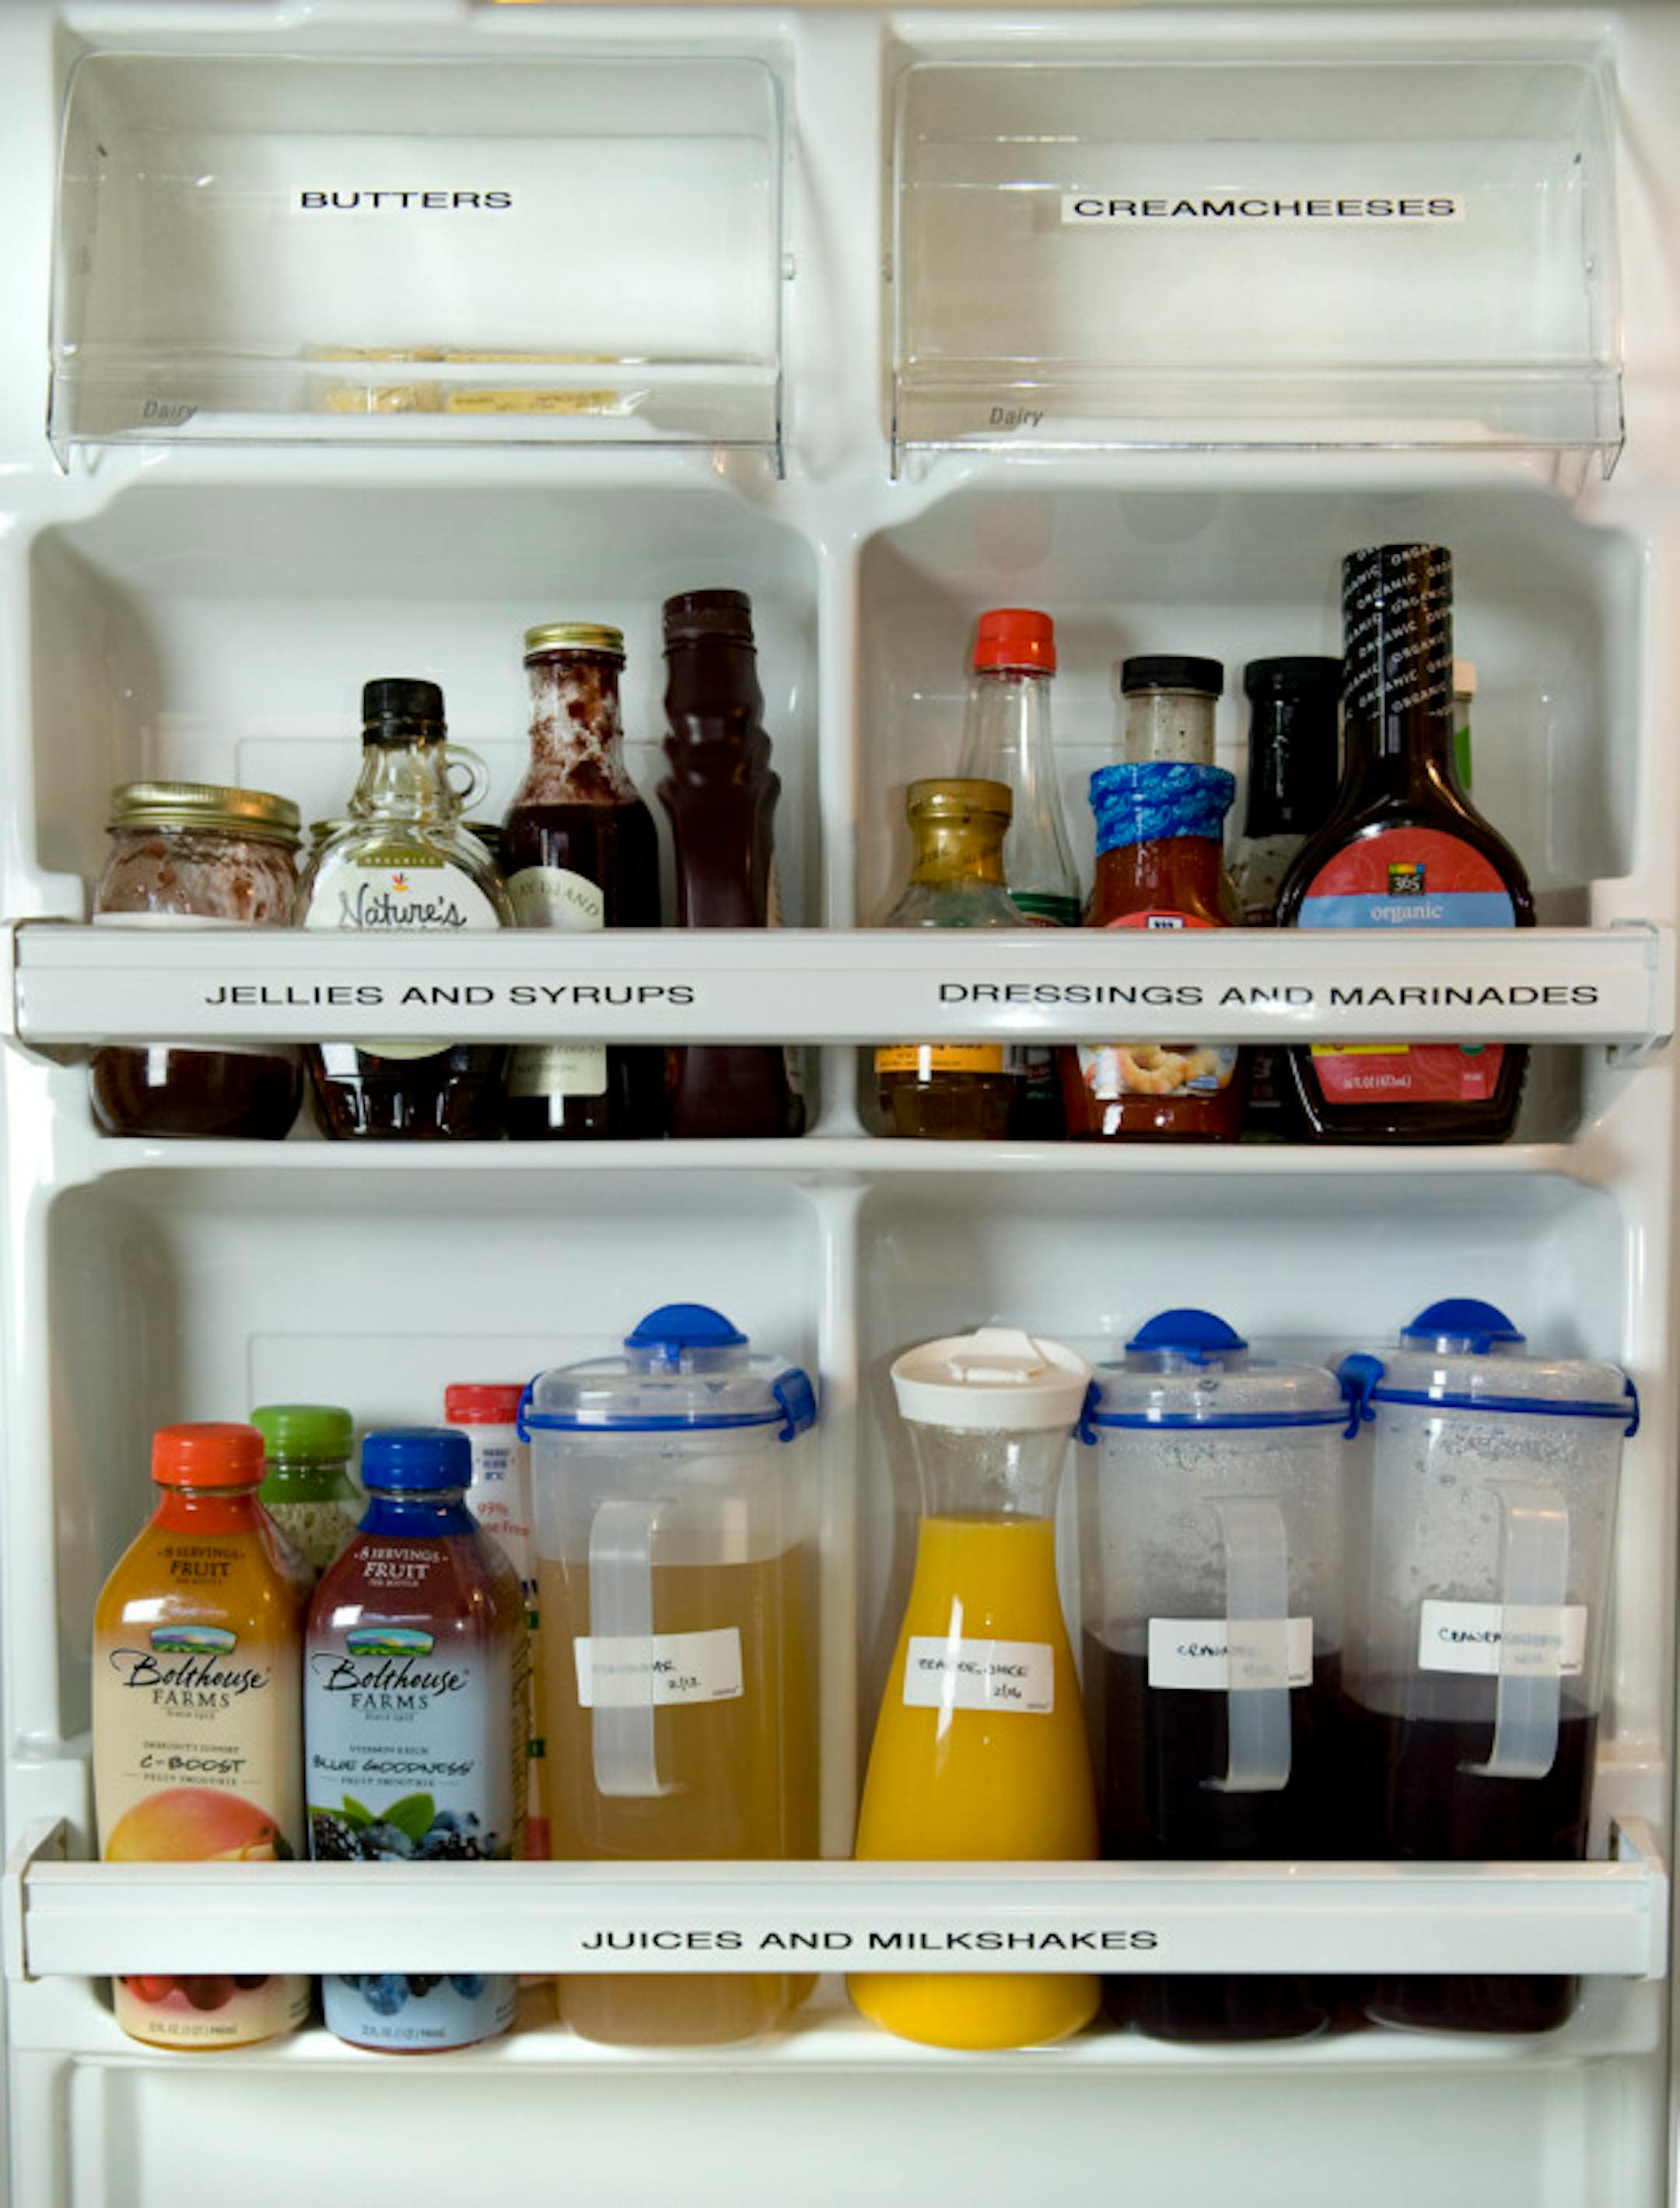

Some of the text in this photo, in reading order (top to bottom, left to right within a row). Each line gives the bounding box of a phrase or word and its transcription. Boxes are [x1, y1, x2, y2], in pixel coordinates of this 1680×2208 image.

[301, 191, 513, 209] BUTTERS
[1073, 199, 1456, 217] CREAMCHEESES
[143, 399, 198, 424] Dairy
[989, 407, 1044, 428] Dairy
[1393, 877, 1421, 892] 365
[339, 882, 467, 926] Nature's
[1370, 901, 1444, 923] organic
[205, 986, 695, 1005] JELLIES AND SYRUPS
[939, 983, 1599, 1006] DRESSINGS AND MARINADES
[170, 1559, 232, 1577] FRUIT
[363, 1562, 432, 1580] FRUIT
[109, 1647, 269, 1696] Bolthouse
[311, 1652, 471, 1697] Bolthouse
[152, 1688, 231, 1708] FARMS
[351, 1692, 429, 1710] FARMS
[312, 1754, 357, 1772] BLUE
[582, 1930, 1159, 1951] JUICES AND MILKSHAKES
